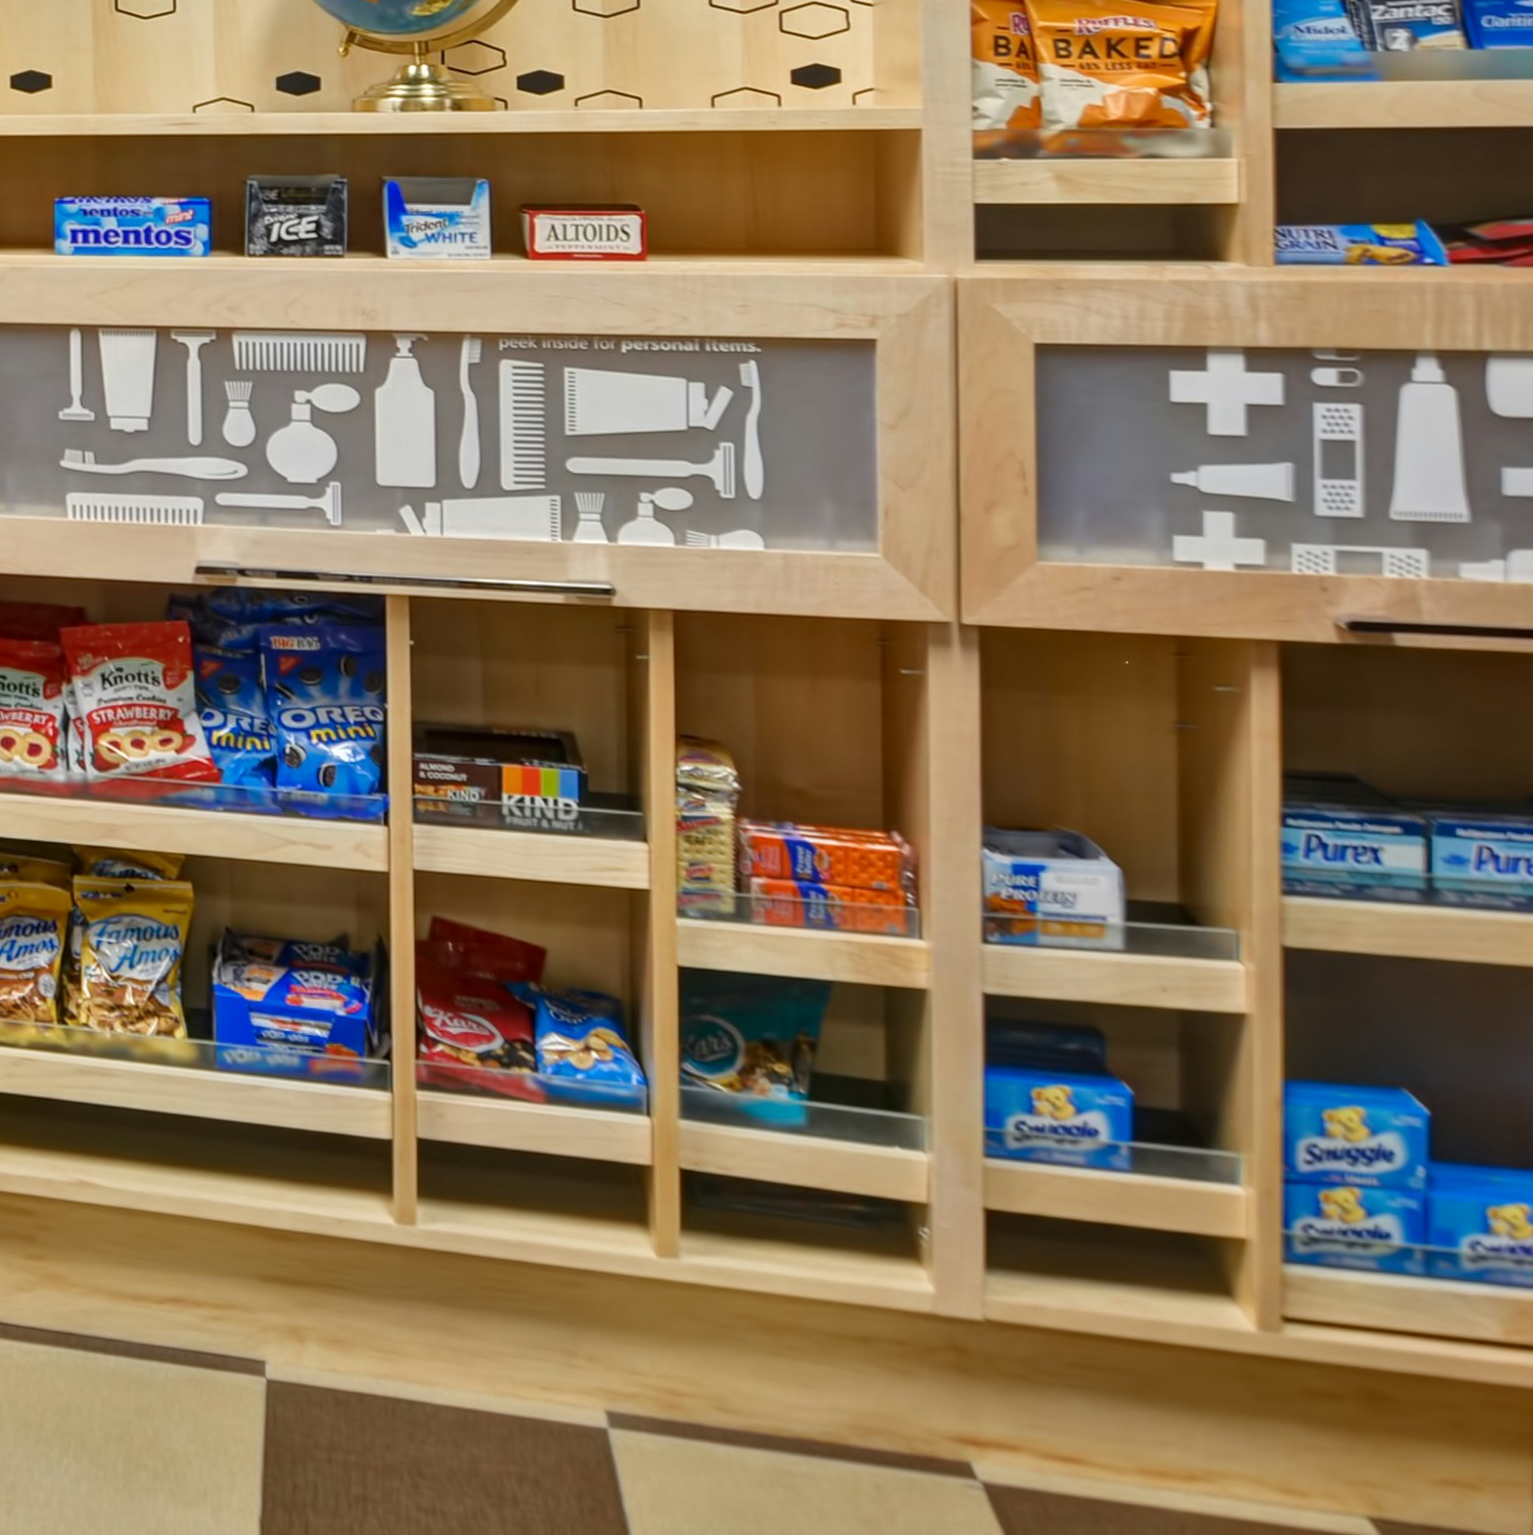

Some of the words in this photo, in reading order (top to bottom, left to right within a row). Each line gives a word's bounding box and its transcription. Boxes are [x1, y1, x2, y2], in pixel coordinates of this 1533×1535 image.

[1371, 4, 1454, 19] Zantac
[1074, 16, 1156, 36] RUFFLES
[1052, 36, 1180, 59] BAKED
[82, 206, 141, 217] entos
[165, 210, 195, 224] mint
[70, 224, 193, 247] mentos
[269, 215, 319, 242] ICE
[405, 218, 449, 235] Trident
[546, 223, 631, 243] ALTOIDS
[1274, 227, 1333, 239] NUTRI
[424, 232, 478, 244] WHITE
[1275, 239, 1338, 251] GRAIN
[499, 337, 537, 350] peek
[542, 337, 588, 350] inside
[593, 337, 617, 350] for
[621, 338, 699, 353] personal
[705, 339, 762, 353] items.
[100, 668, 161, 690] Knott's
[91, 707, 175, 725] STRAWBERRY
[210, 729, 271, 751] mini
[310, 723, 376, 743] mini
[419, 762, 456, 772] ALMOND
[426, 771, 468, 782] COCONUT
[447, 789, 481, 801] KIND
[501, 793, 579, 821] KIND
[1301, 832, 1385, 866] Purex
[1474, 844, 1533, 874] Pure
[991, 872, 1039, 887] PURE
[1000, 886, 1077, 906] PROTEIN
[89, 921, 181, 951] Famous
[110, 944, 182, 972] Amos
[1304, 1143, 1396, 1167] Snuggle
